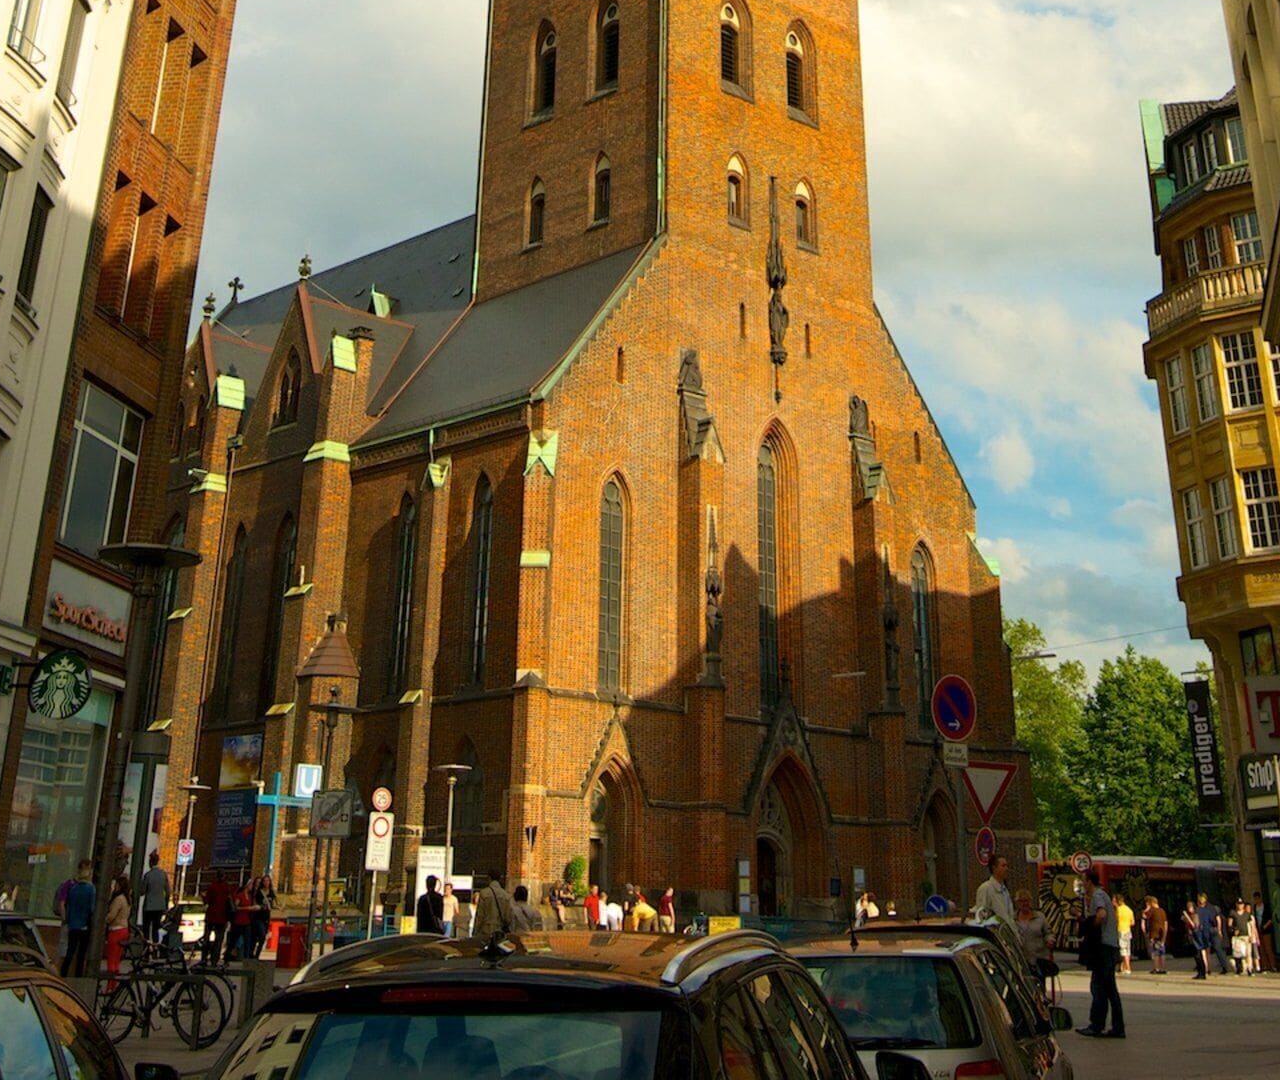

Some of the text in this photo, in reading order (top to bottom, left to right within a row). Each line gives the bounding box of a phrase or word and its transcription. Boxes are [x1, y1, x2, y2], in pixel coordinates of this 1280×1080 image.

[1192, 714, 1222, 796] prediger
[299, 766, 320, 795] U
[1077, 856, 1089, 869] 25
